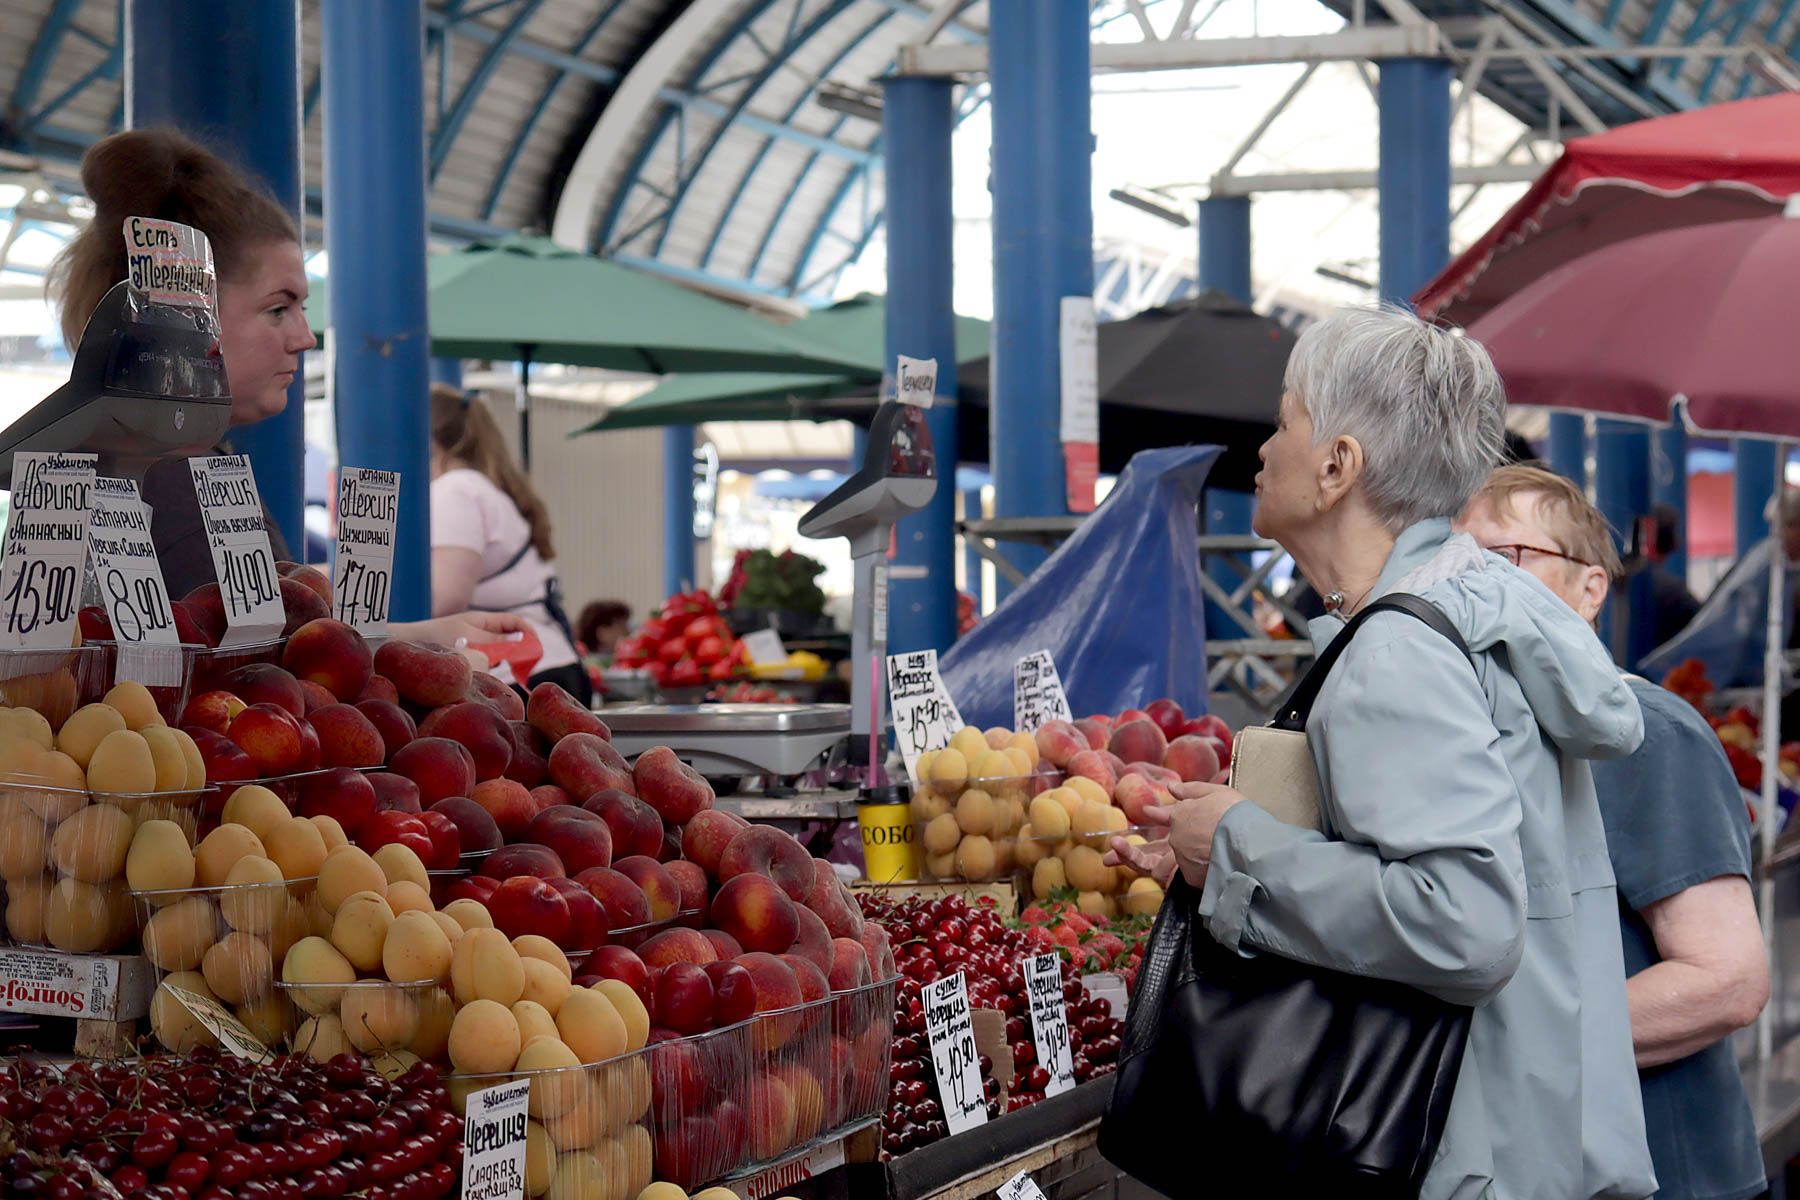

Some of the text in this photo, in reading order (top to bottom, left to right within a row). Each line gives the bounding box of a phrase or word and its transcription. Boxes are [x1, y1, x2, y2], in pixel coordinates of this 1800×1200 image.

[131, 218, 179, 248] Есть
[194, 470, 257, 509] Персик
[340, 478, 396, 525] Персик
[10, 510, 83, 542] Ананасный
[338, 520, 390, 547] Инжирный
[465, 1112, 528, 1158] Черешня
